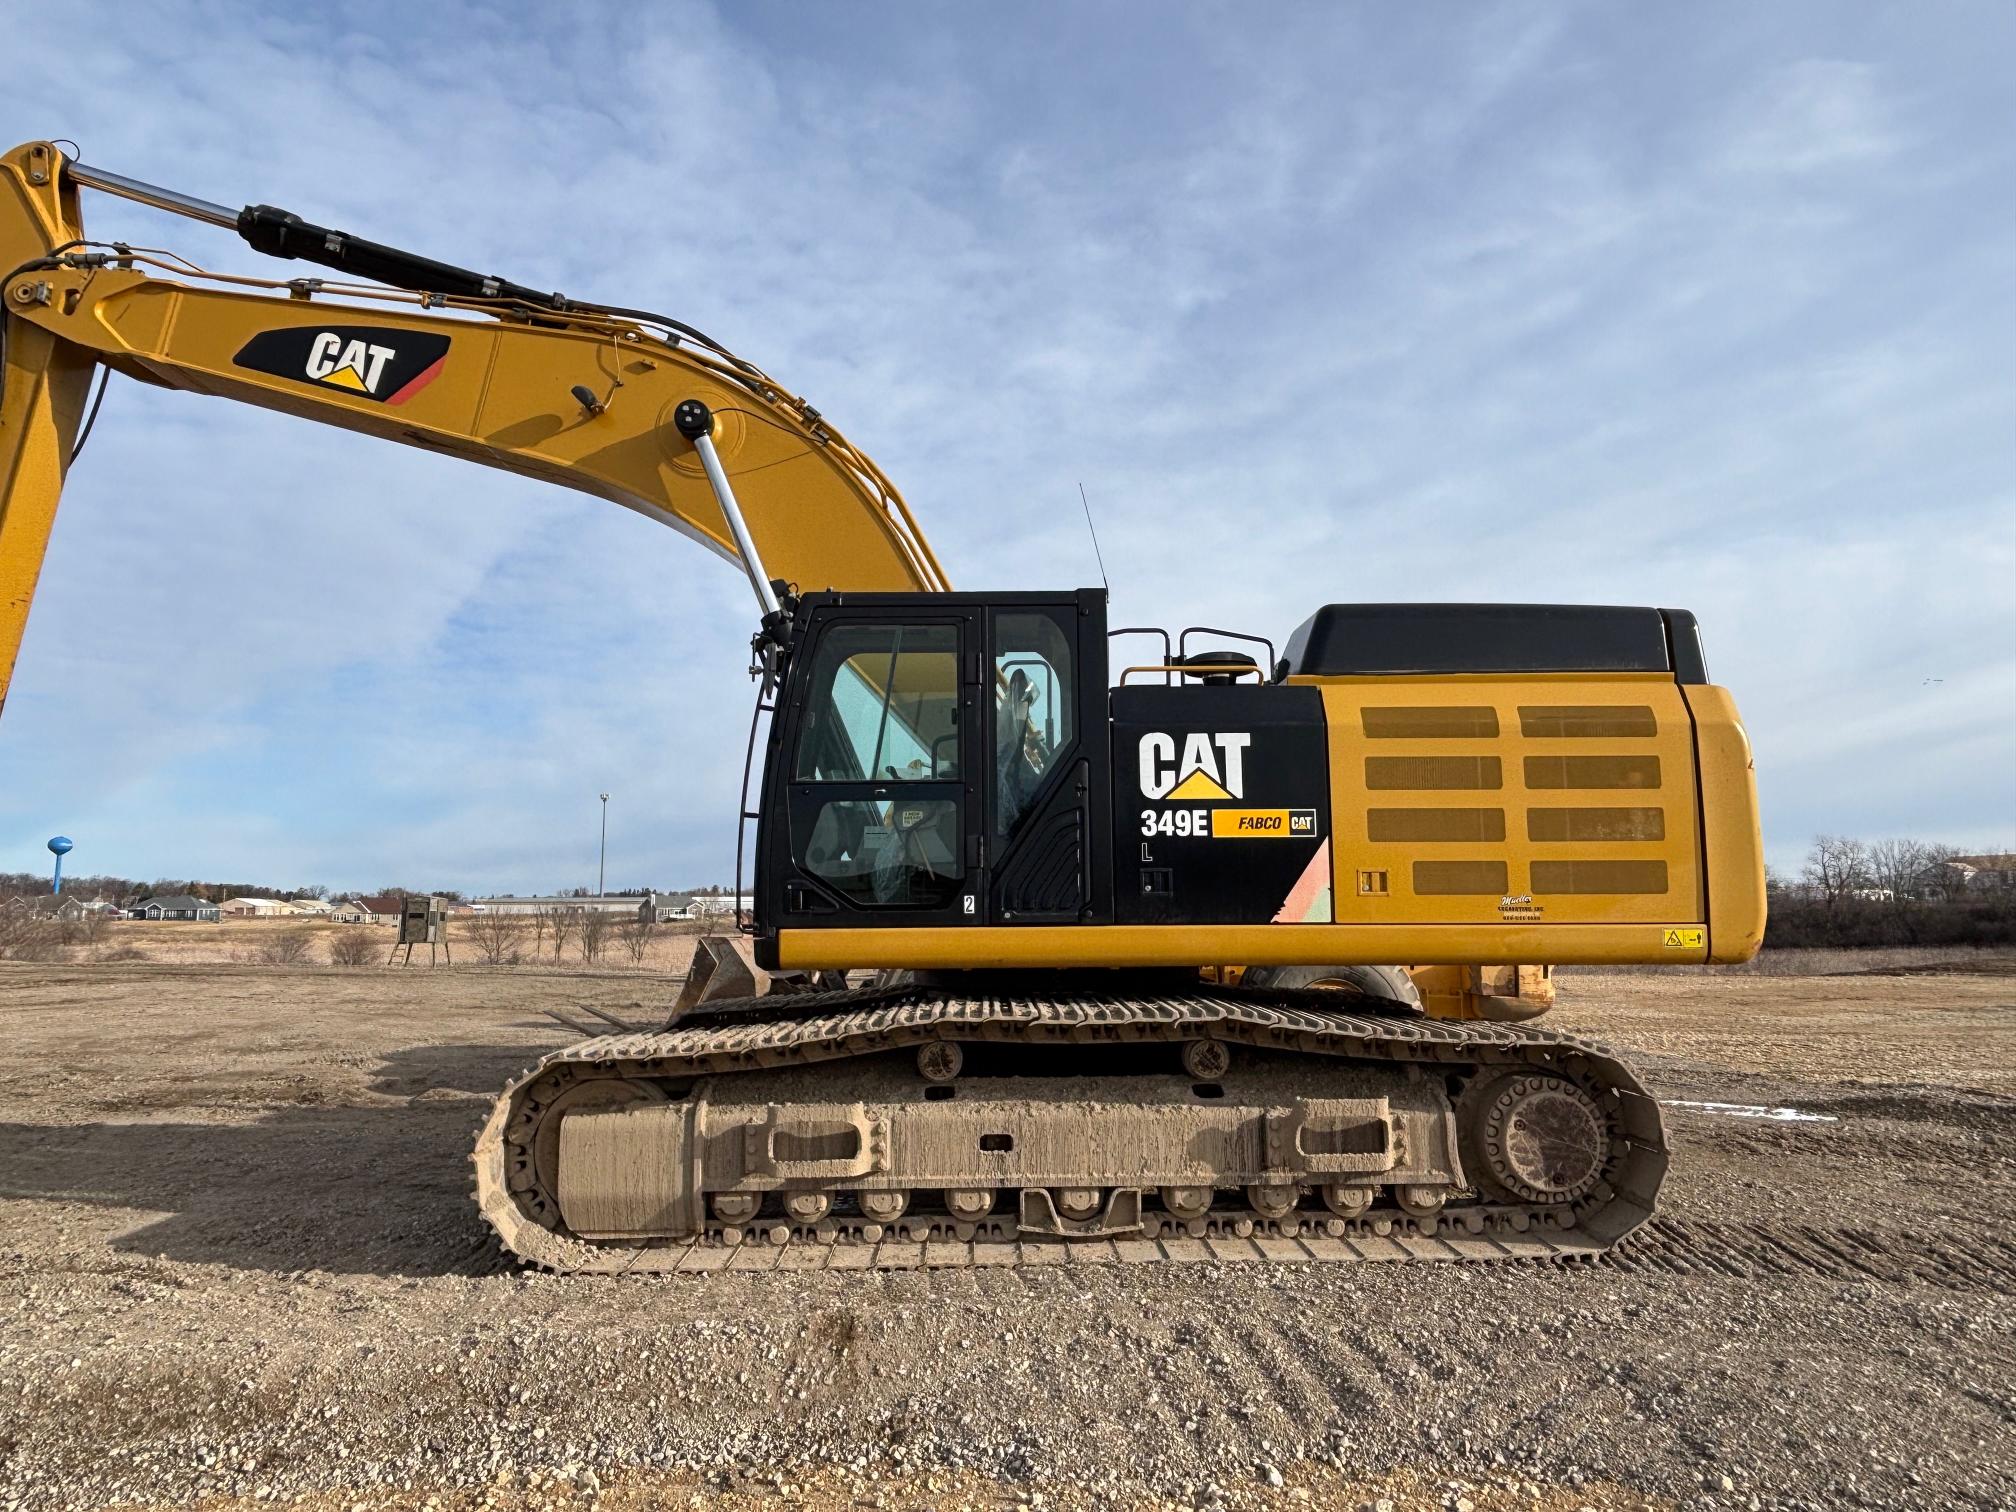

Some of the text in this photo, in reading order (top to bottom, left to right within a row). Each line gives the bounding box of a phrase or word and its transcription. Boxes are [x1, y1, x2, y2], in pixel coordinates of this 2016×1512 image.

[305, 332, 396, 394] CAT
[1138, 732, 1251, 800] CAT
[1140, 809, 1208, 837] 349E
[1238, 816, 1312, 830] FABCO CAT
[1141, 843, 1153, 862] L
